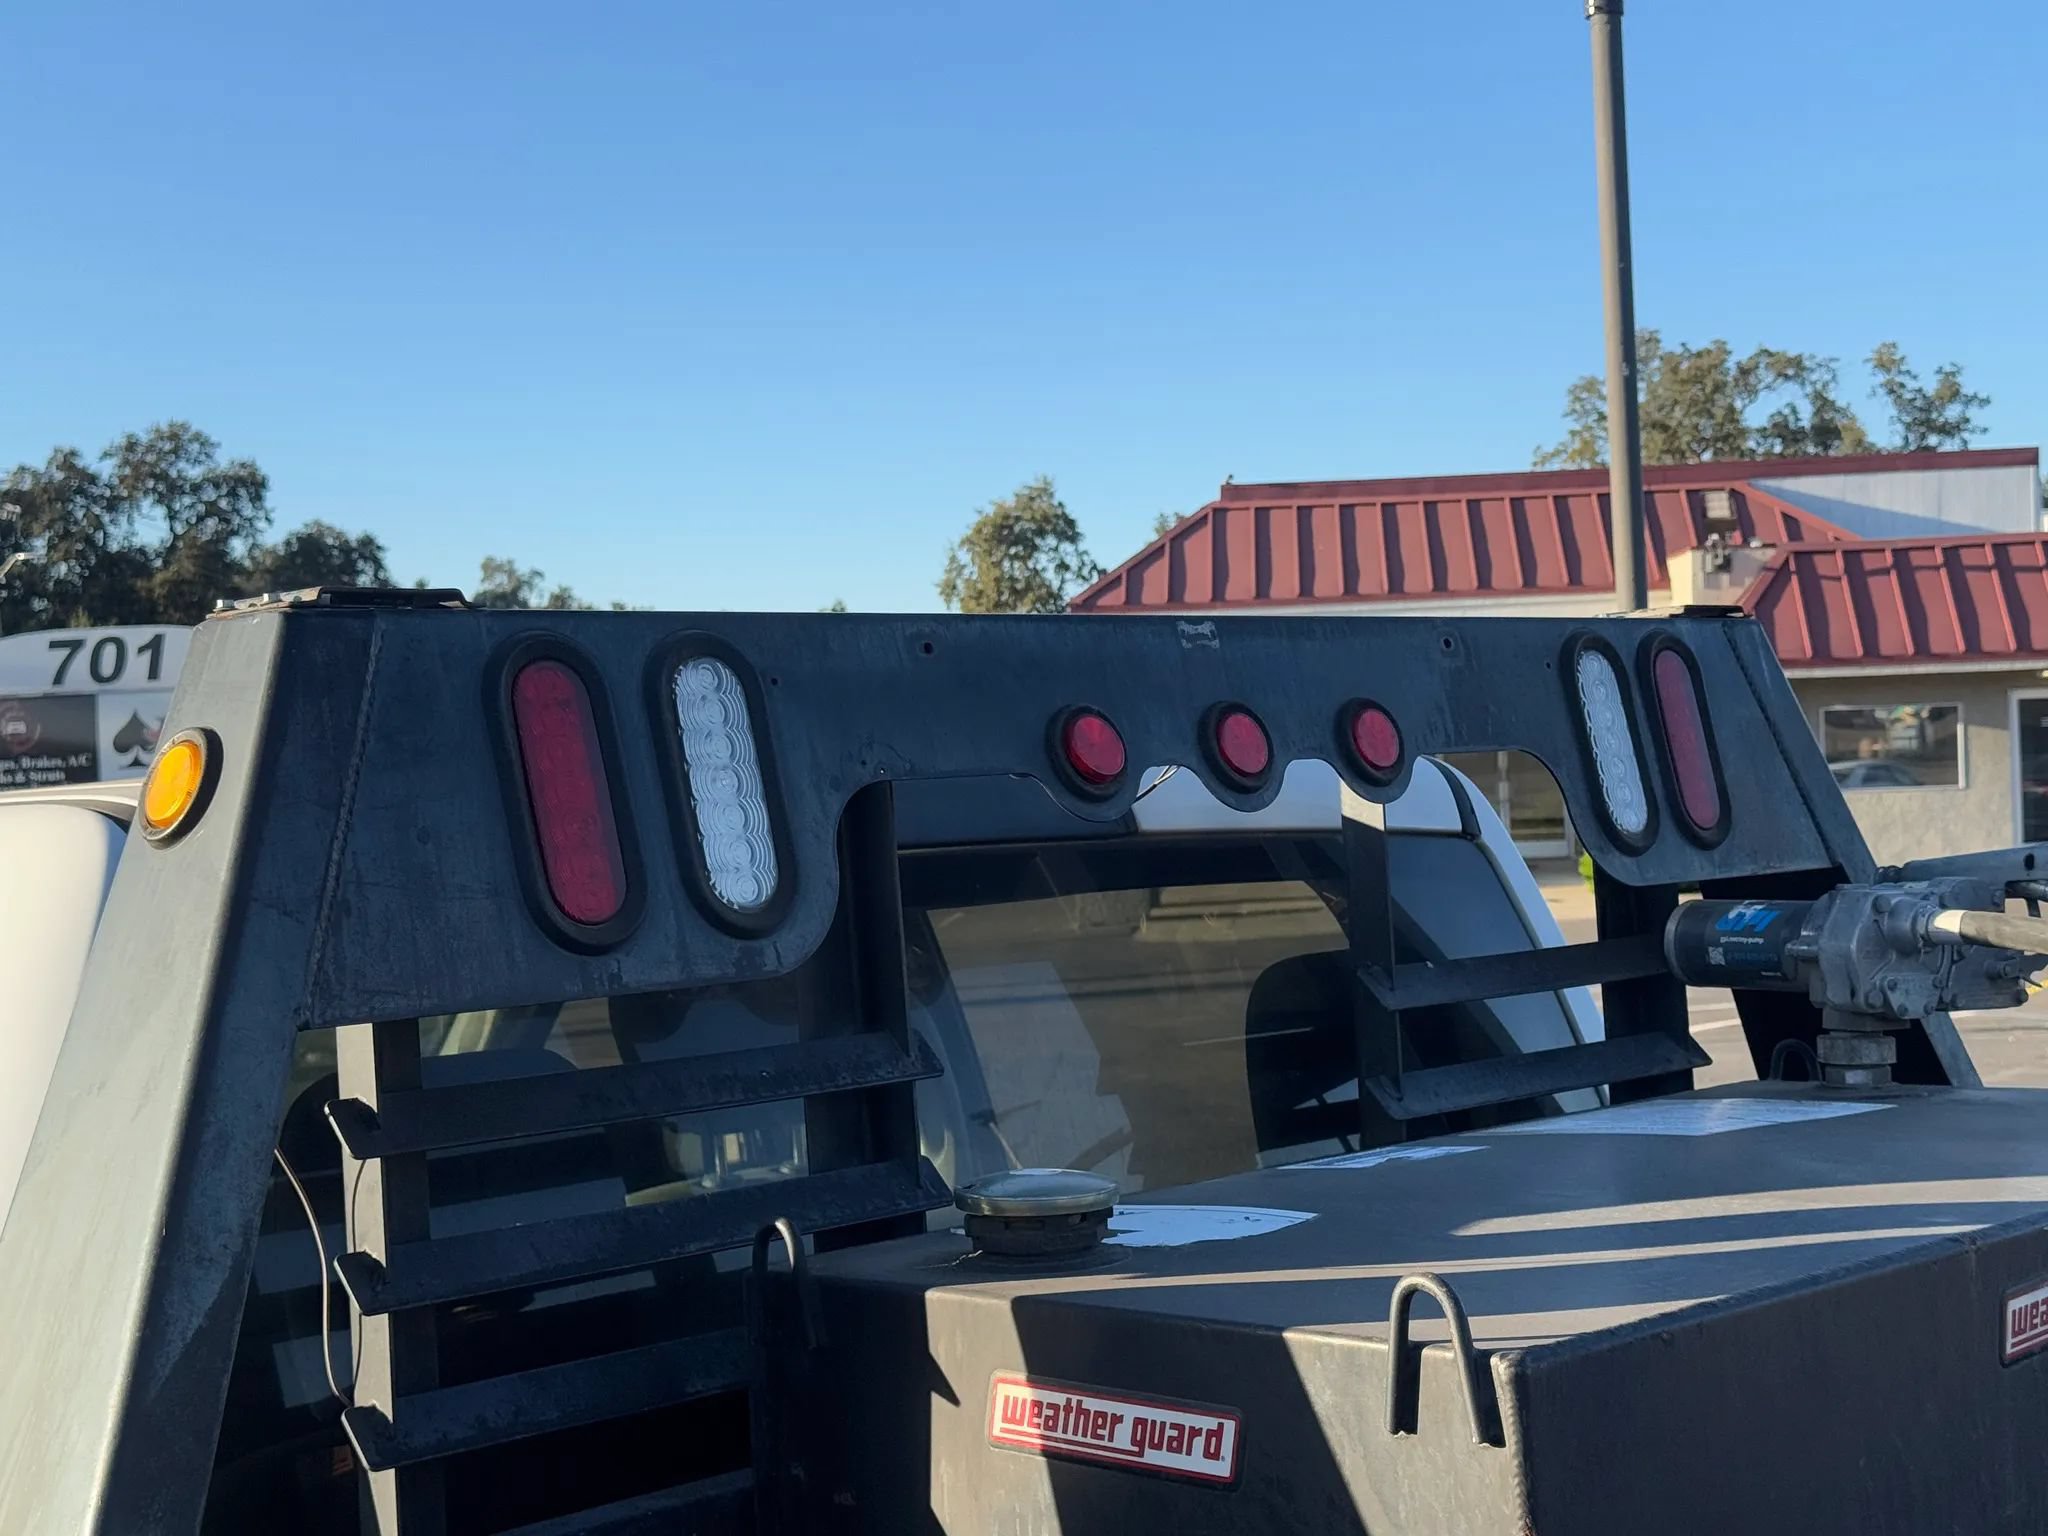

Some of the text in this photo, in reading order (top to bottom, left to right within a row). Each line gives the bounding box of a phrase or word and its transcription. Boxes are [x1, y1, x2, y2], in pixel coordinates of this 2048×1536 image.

[48, 633, 166, 686] 701
[1001, 1394, 1225, 1462] weather guard
